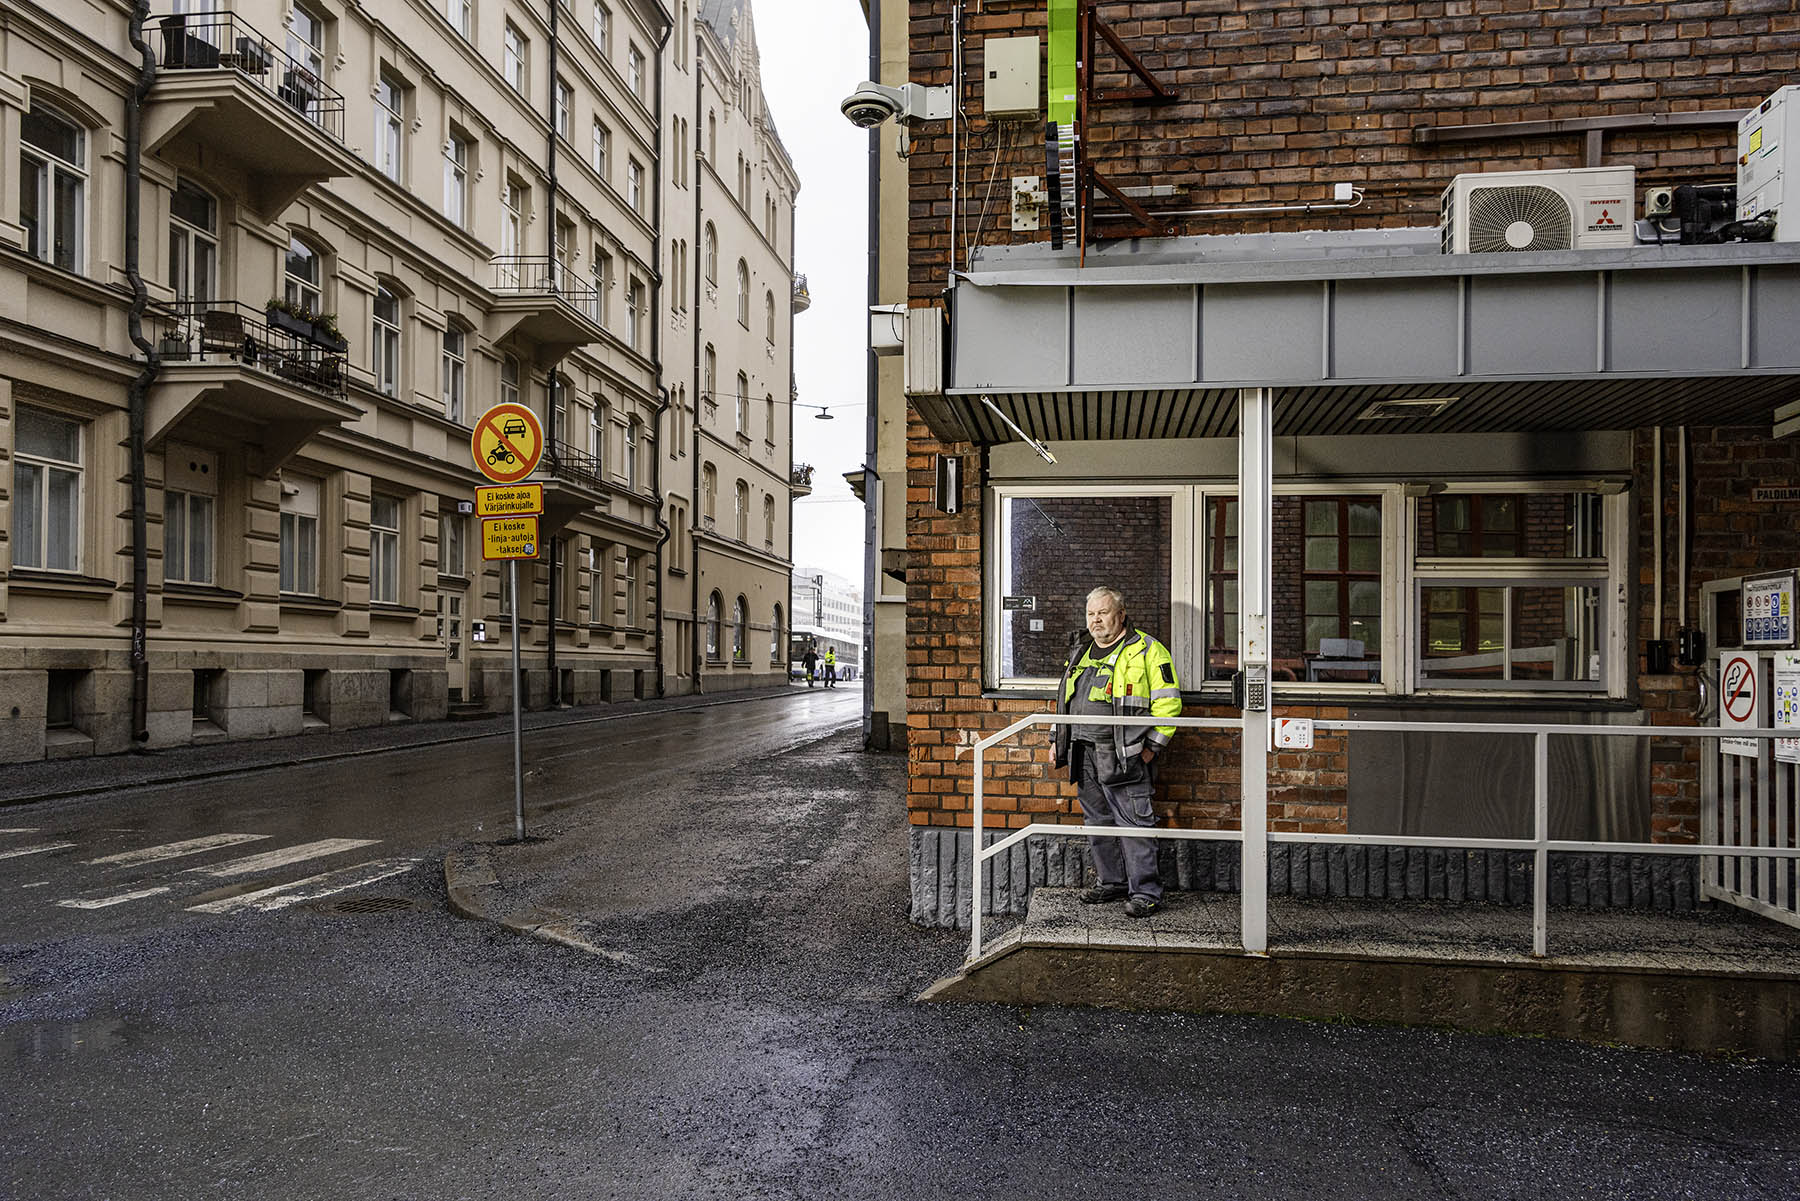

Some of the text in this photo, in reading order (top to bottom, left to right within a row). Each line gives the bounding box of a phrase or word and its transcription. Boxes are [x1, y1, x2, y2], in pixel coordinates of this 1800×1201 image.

[487, 490, 530, 501] Ei koske ajoa
[1757, 489, 1800, 500] PALOILM
[484, 500, 534, 512] Värjärinkujalle
[493, 522, 525, 531] Ei koske
[496, 544, 524, 554] -taksej
